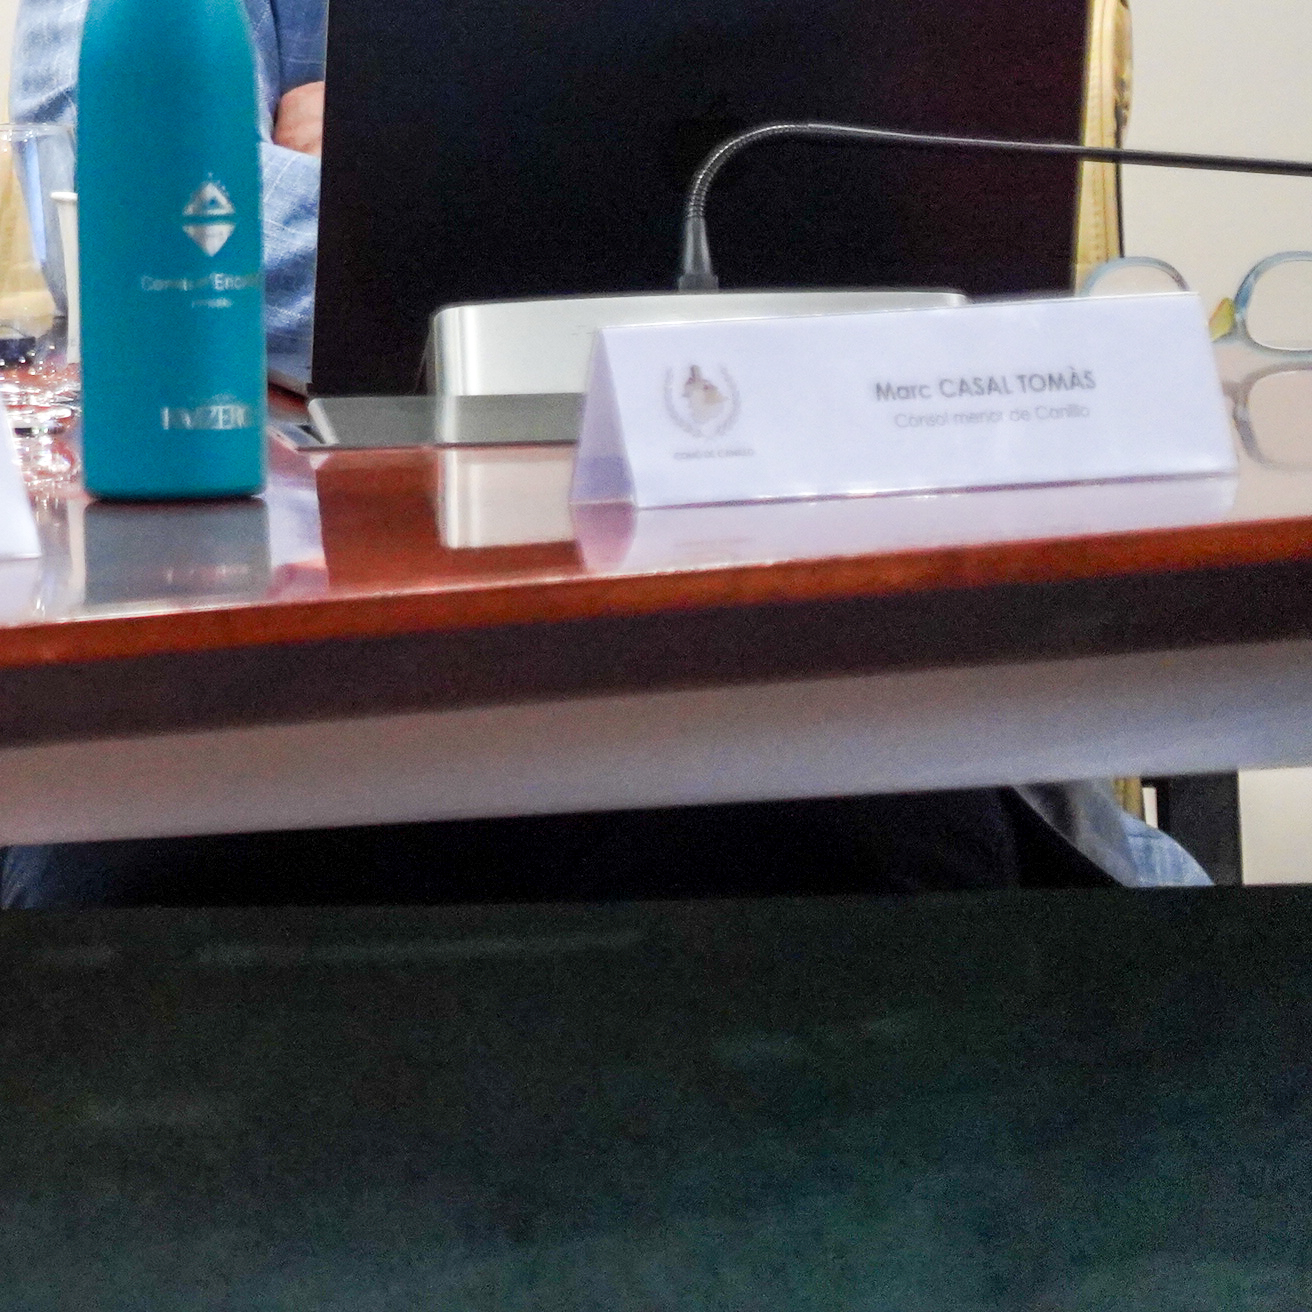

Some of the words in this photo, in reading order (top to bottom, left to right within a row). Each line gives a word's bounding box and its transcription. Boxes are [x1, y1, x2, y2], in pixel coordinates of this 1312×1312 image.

[874, 381, 932, 401] Marc
[938, 376, 1013, 398] CASAL
[1016, 366, 1096, 392] TOMÀS
[954, 410, 1003, 424] menor
[1009, 407, 1031, 422] de
[1035, 403, 1091, 419] Canillo
